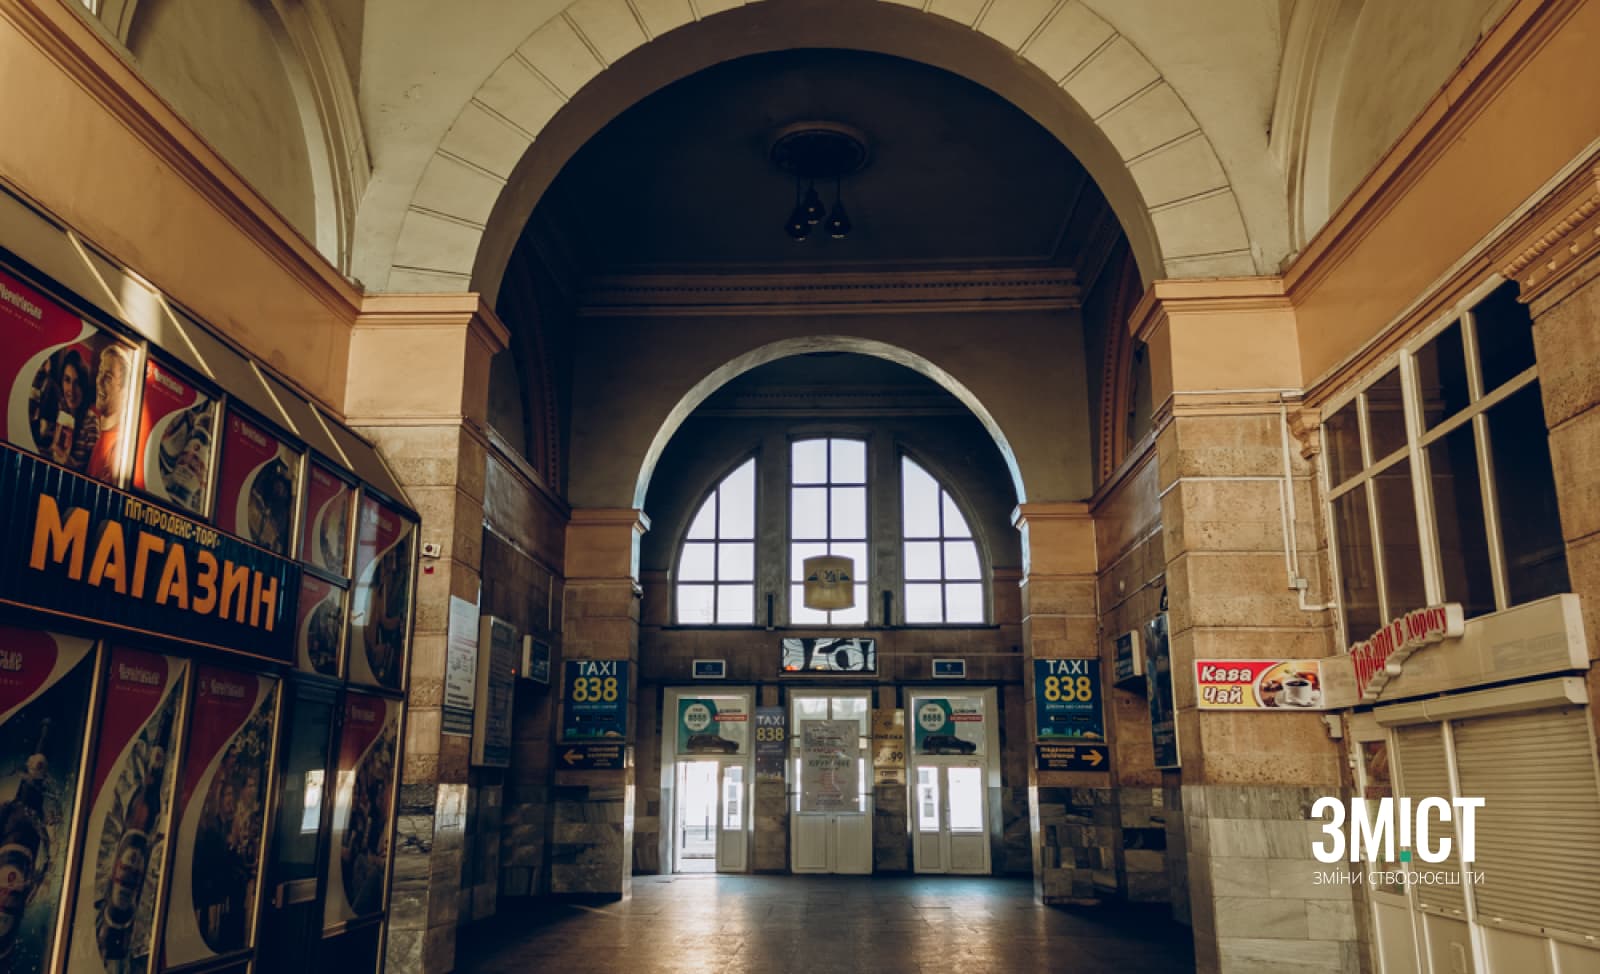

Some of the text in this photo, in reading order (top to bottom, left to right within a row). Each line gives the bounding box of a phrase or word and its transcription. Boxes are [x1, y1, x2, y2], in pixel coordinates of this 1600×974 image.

[29, 493, 278, 632] МАГАЗИН
[575, 660, 618, 676] TAXI
[1046, 659, 1090, 675] TAXI
[1200, 665, 1253, 683] Кава
[572, 676, 619, 702] 838
[1044, 675, 1093, 702] 838
[1203, 686, 1243, 704] Чай
[757, 715, 785, 726] TAXI
[757, 727, 785, 741] 838
